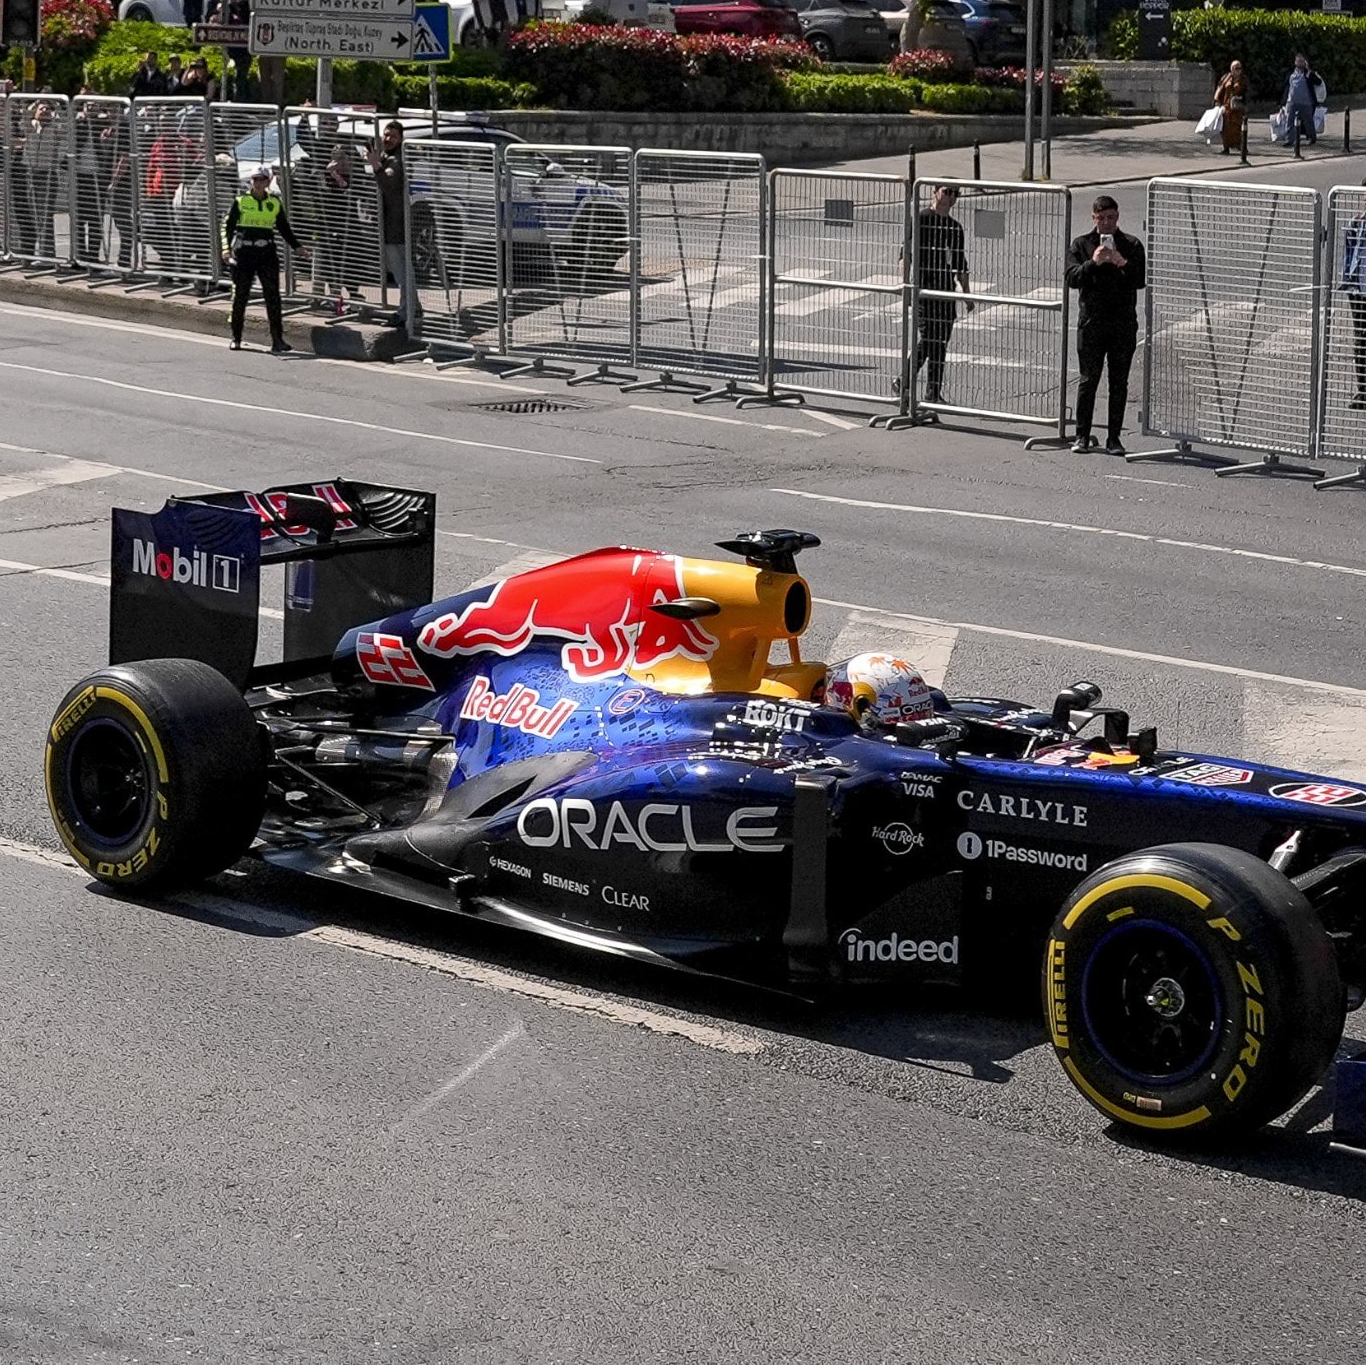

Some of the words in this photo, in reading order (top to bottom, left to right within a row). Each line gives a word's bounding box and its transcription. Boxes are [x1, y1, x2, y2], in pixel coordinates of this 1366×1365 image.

[339, 39, 374, 54] East)
[133, 538, 207, 588] Mobil
[52, 685, 97, 743] PIRELLI
[901, 700, 934, 715] ORAC
[902, 782, 935, 798] VISA
[517, 798, 785, 852] ORACLE
[957, 790, 1088, 827] CARLYLE
[96, 826, 161, 877] ZERO
[871, 826, 898, 841] Hard
[898, 829, 925, 847] Rock
[497, 857, 532, 879] HEXAGON
[986, 839, 1088, 872] 1Password
[542, 872, 590, 896] SIEMENS
[844, 930, 959, 964] indeed
[1047, 938, 1069, 1049] PIRELLI
[1223, 961, 1266, 1102] ZERO
